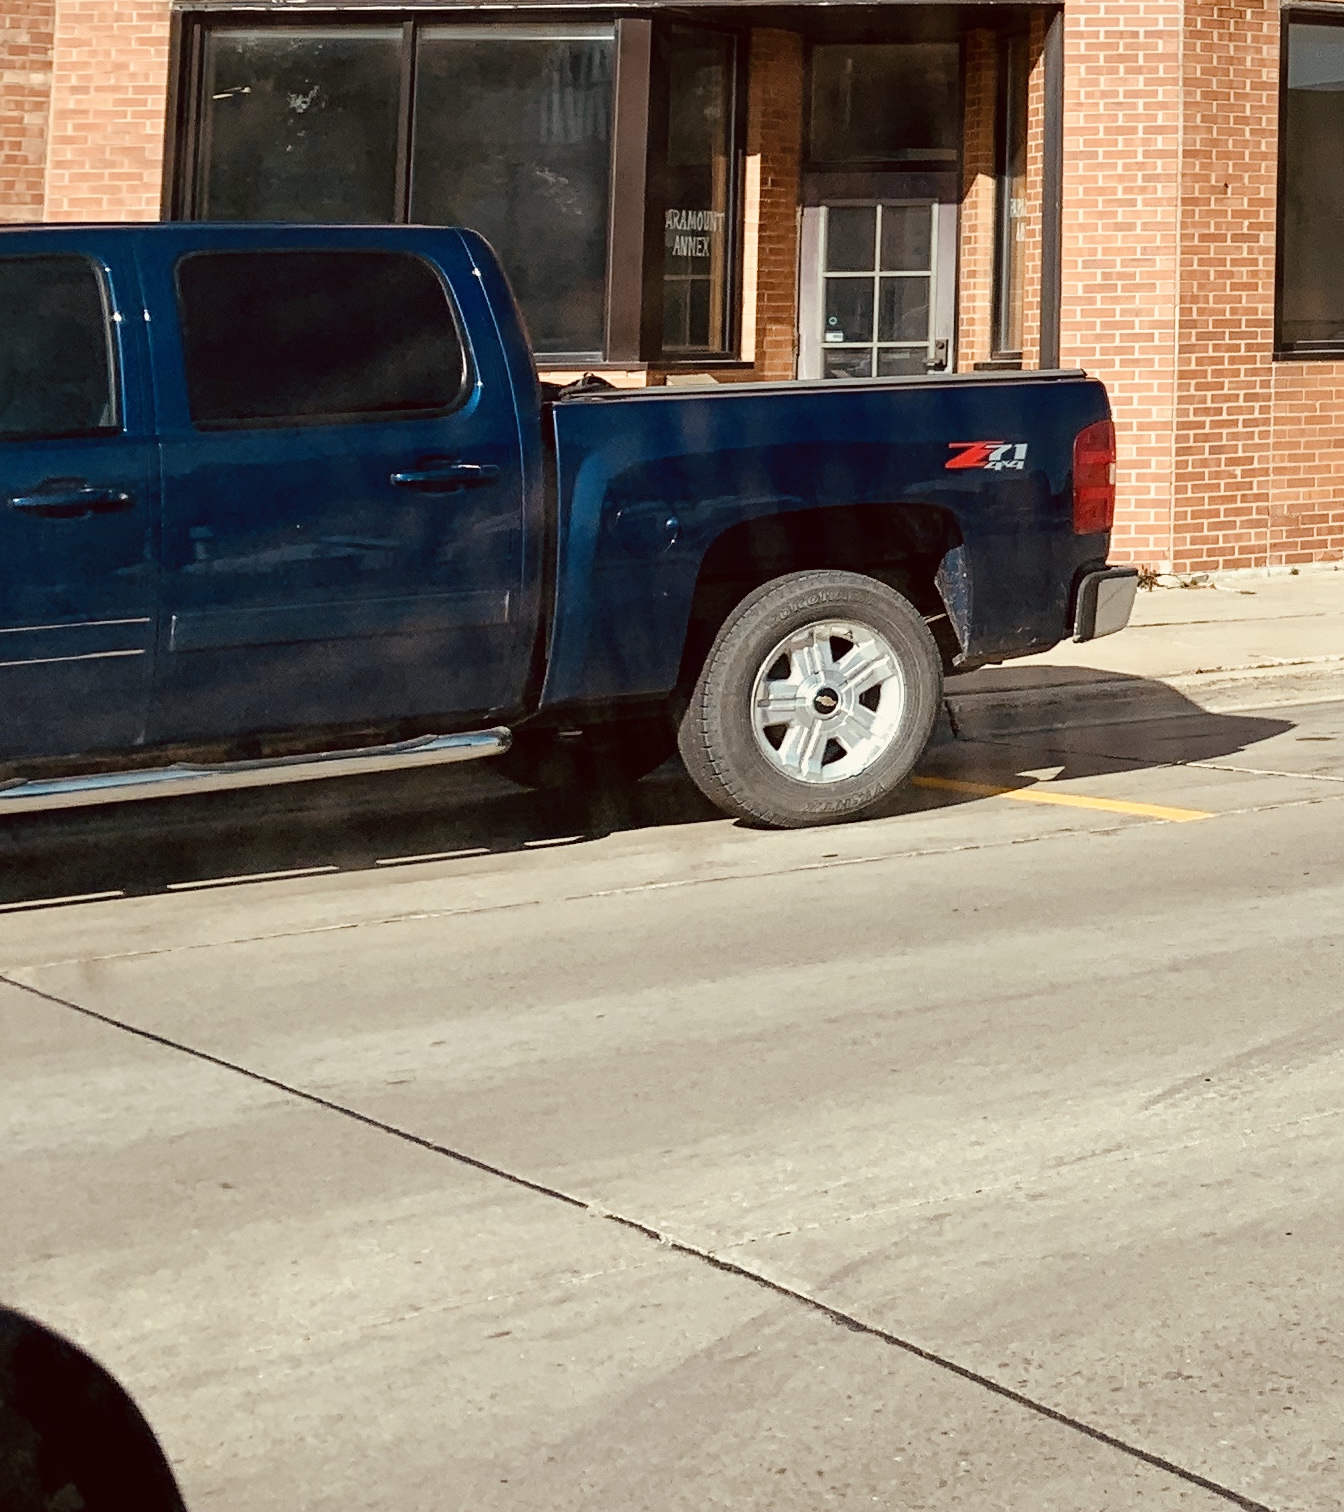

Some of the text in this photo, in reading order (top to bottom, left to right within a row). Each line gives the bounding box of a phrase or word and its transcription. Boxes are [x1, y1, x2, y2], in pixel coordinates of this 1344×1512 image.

[665, 208, 725, 233] ARAMOUNT
[671, 235, 711, 257] ANNEX
[945, 440, 1029, 469] Z71
